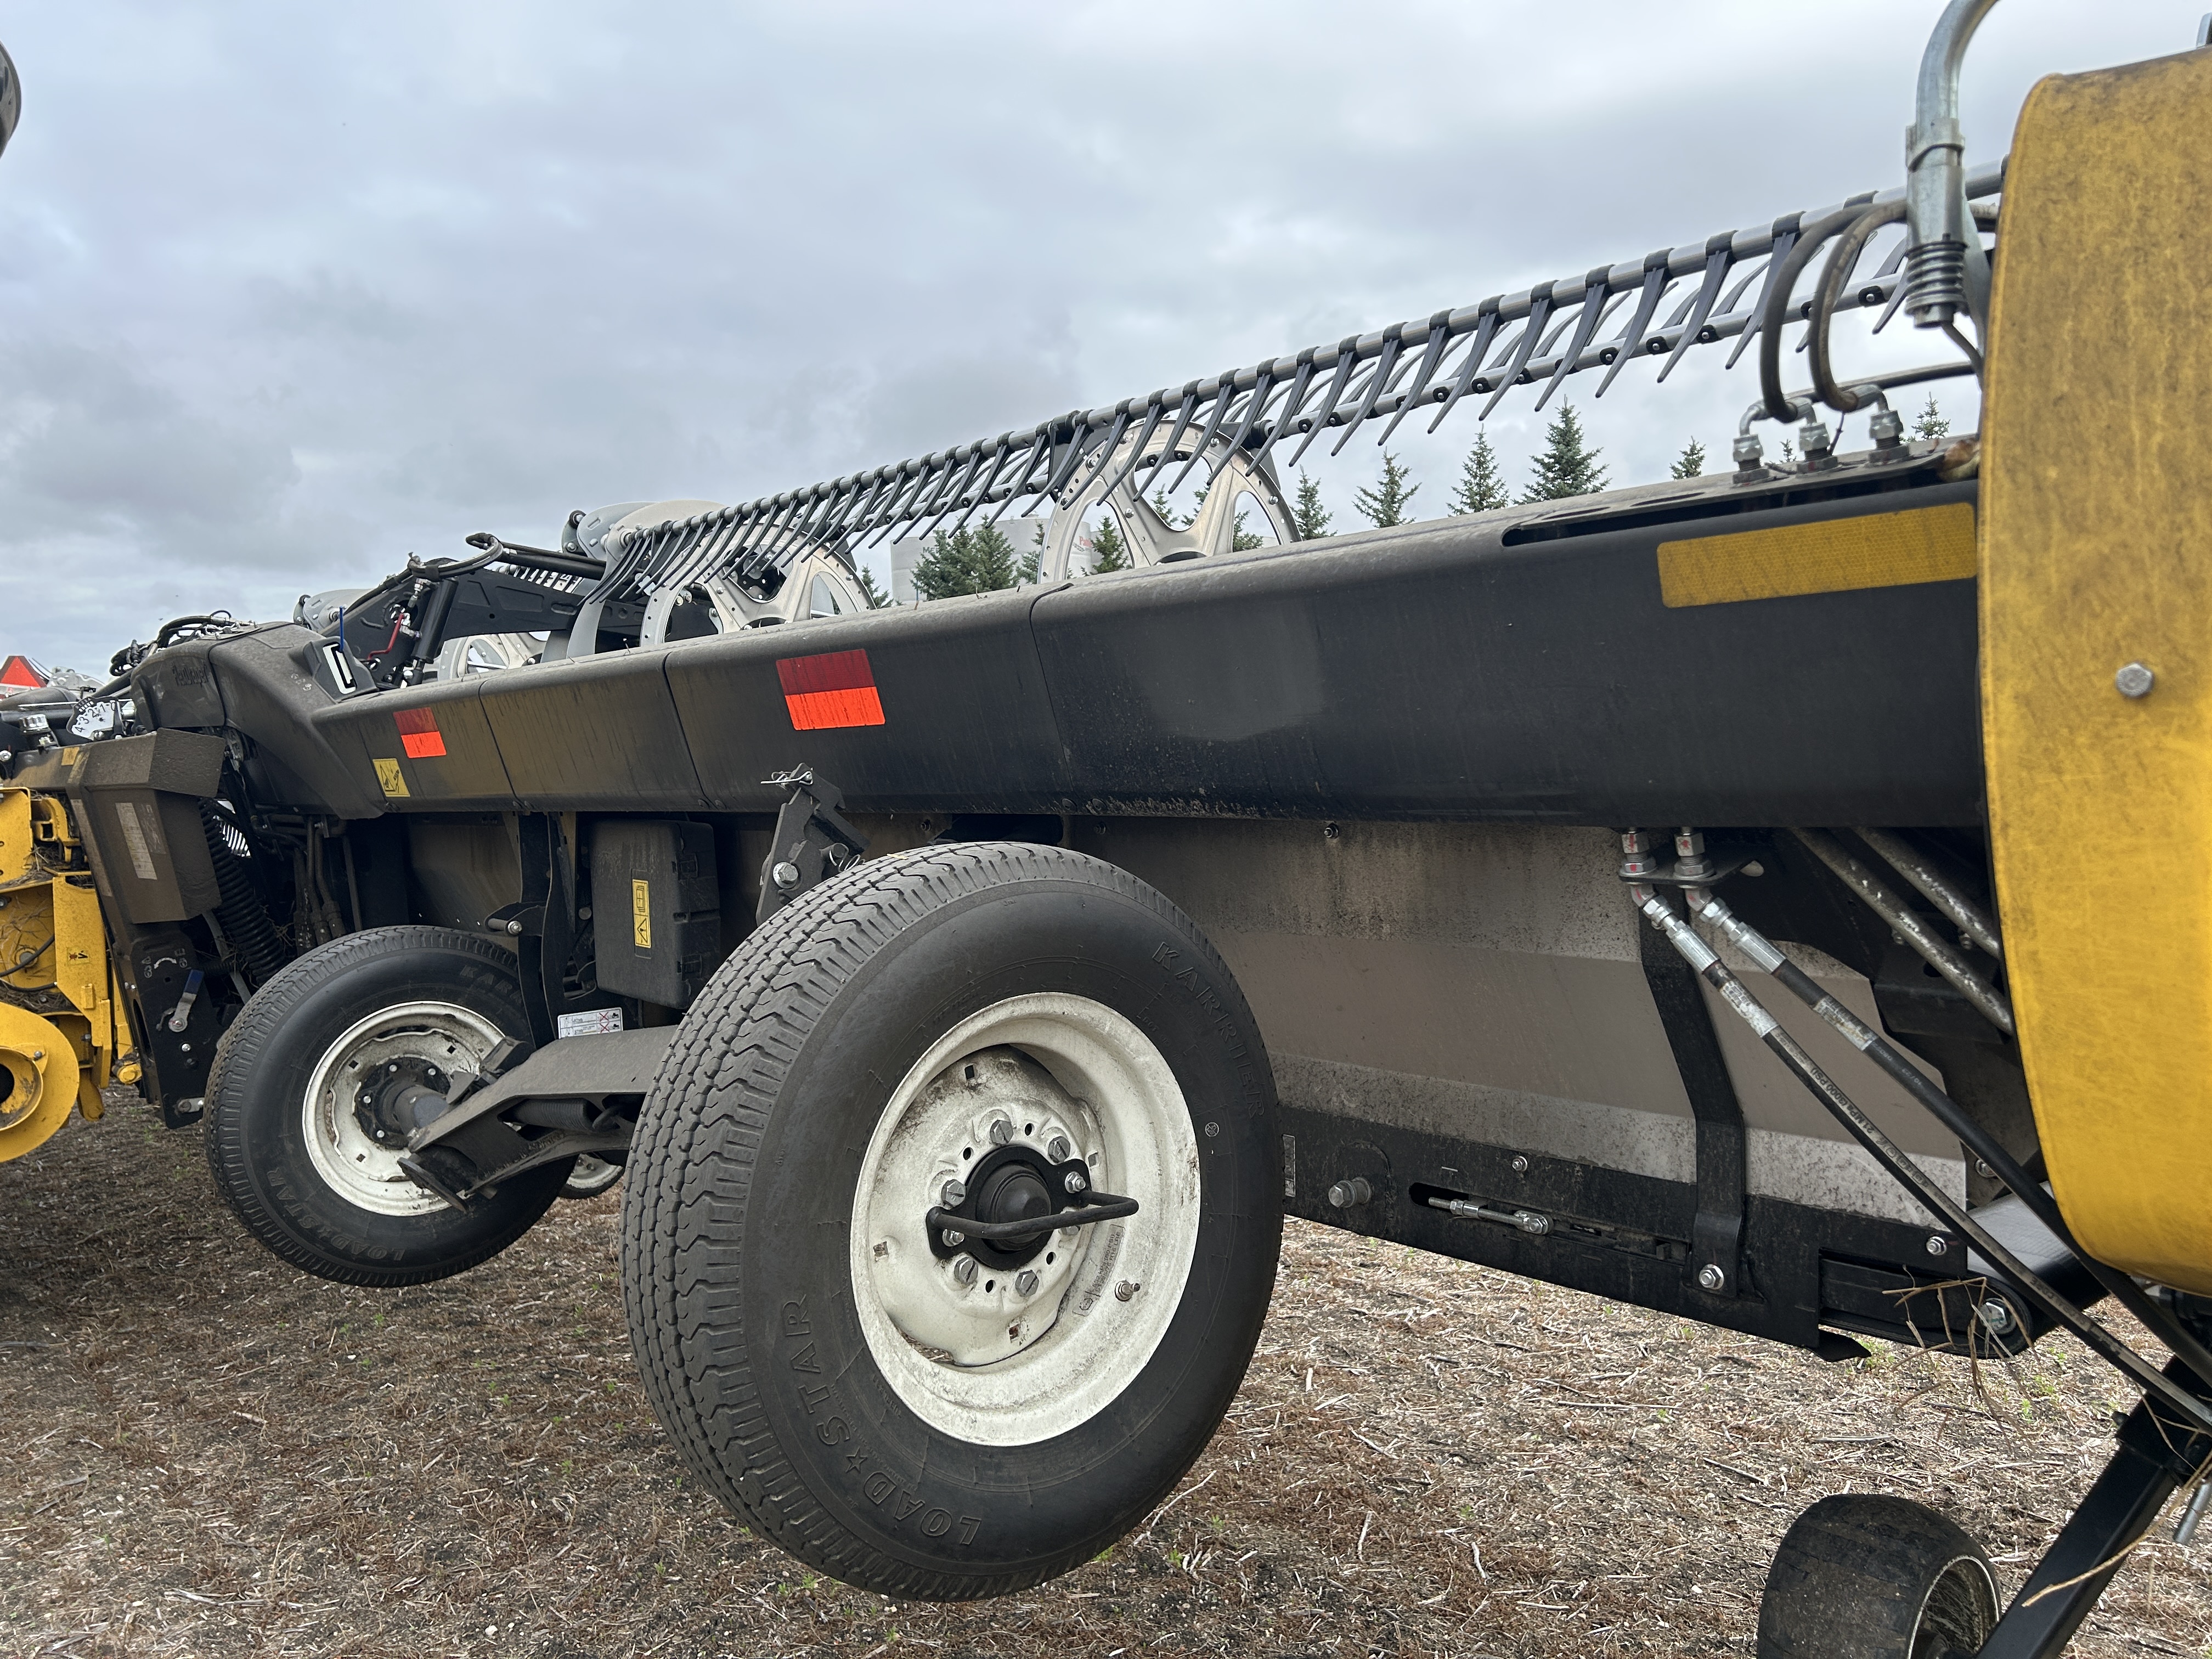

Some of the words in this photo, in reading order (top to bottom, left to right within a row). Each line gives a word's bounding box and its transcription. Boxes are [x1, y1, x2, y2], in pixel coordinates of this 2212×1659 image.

[1152, 941, 1265, 1119] KARRIER
[1809, 1066, 1829, 1086] PSI)
[1824, 1082, 1849, 1107] (3000
[1845, 1104, 1865, 1124] MPa
[1862, 1121, 1875, 1134] 21
[782, 1294, 851, 1447] STAR
[863, 1470, 981, 1546] LOAD
